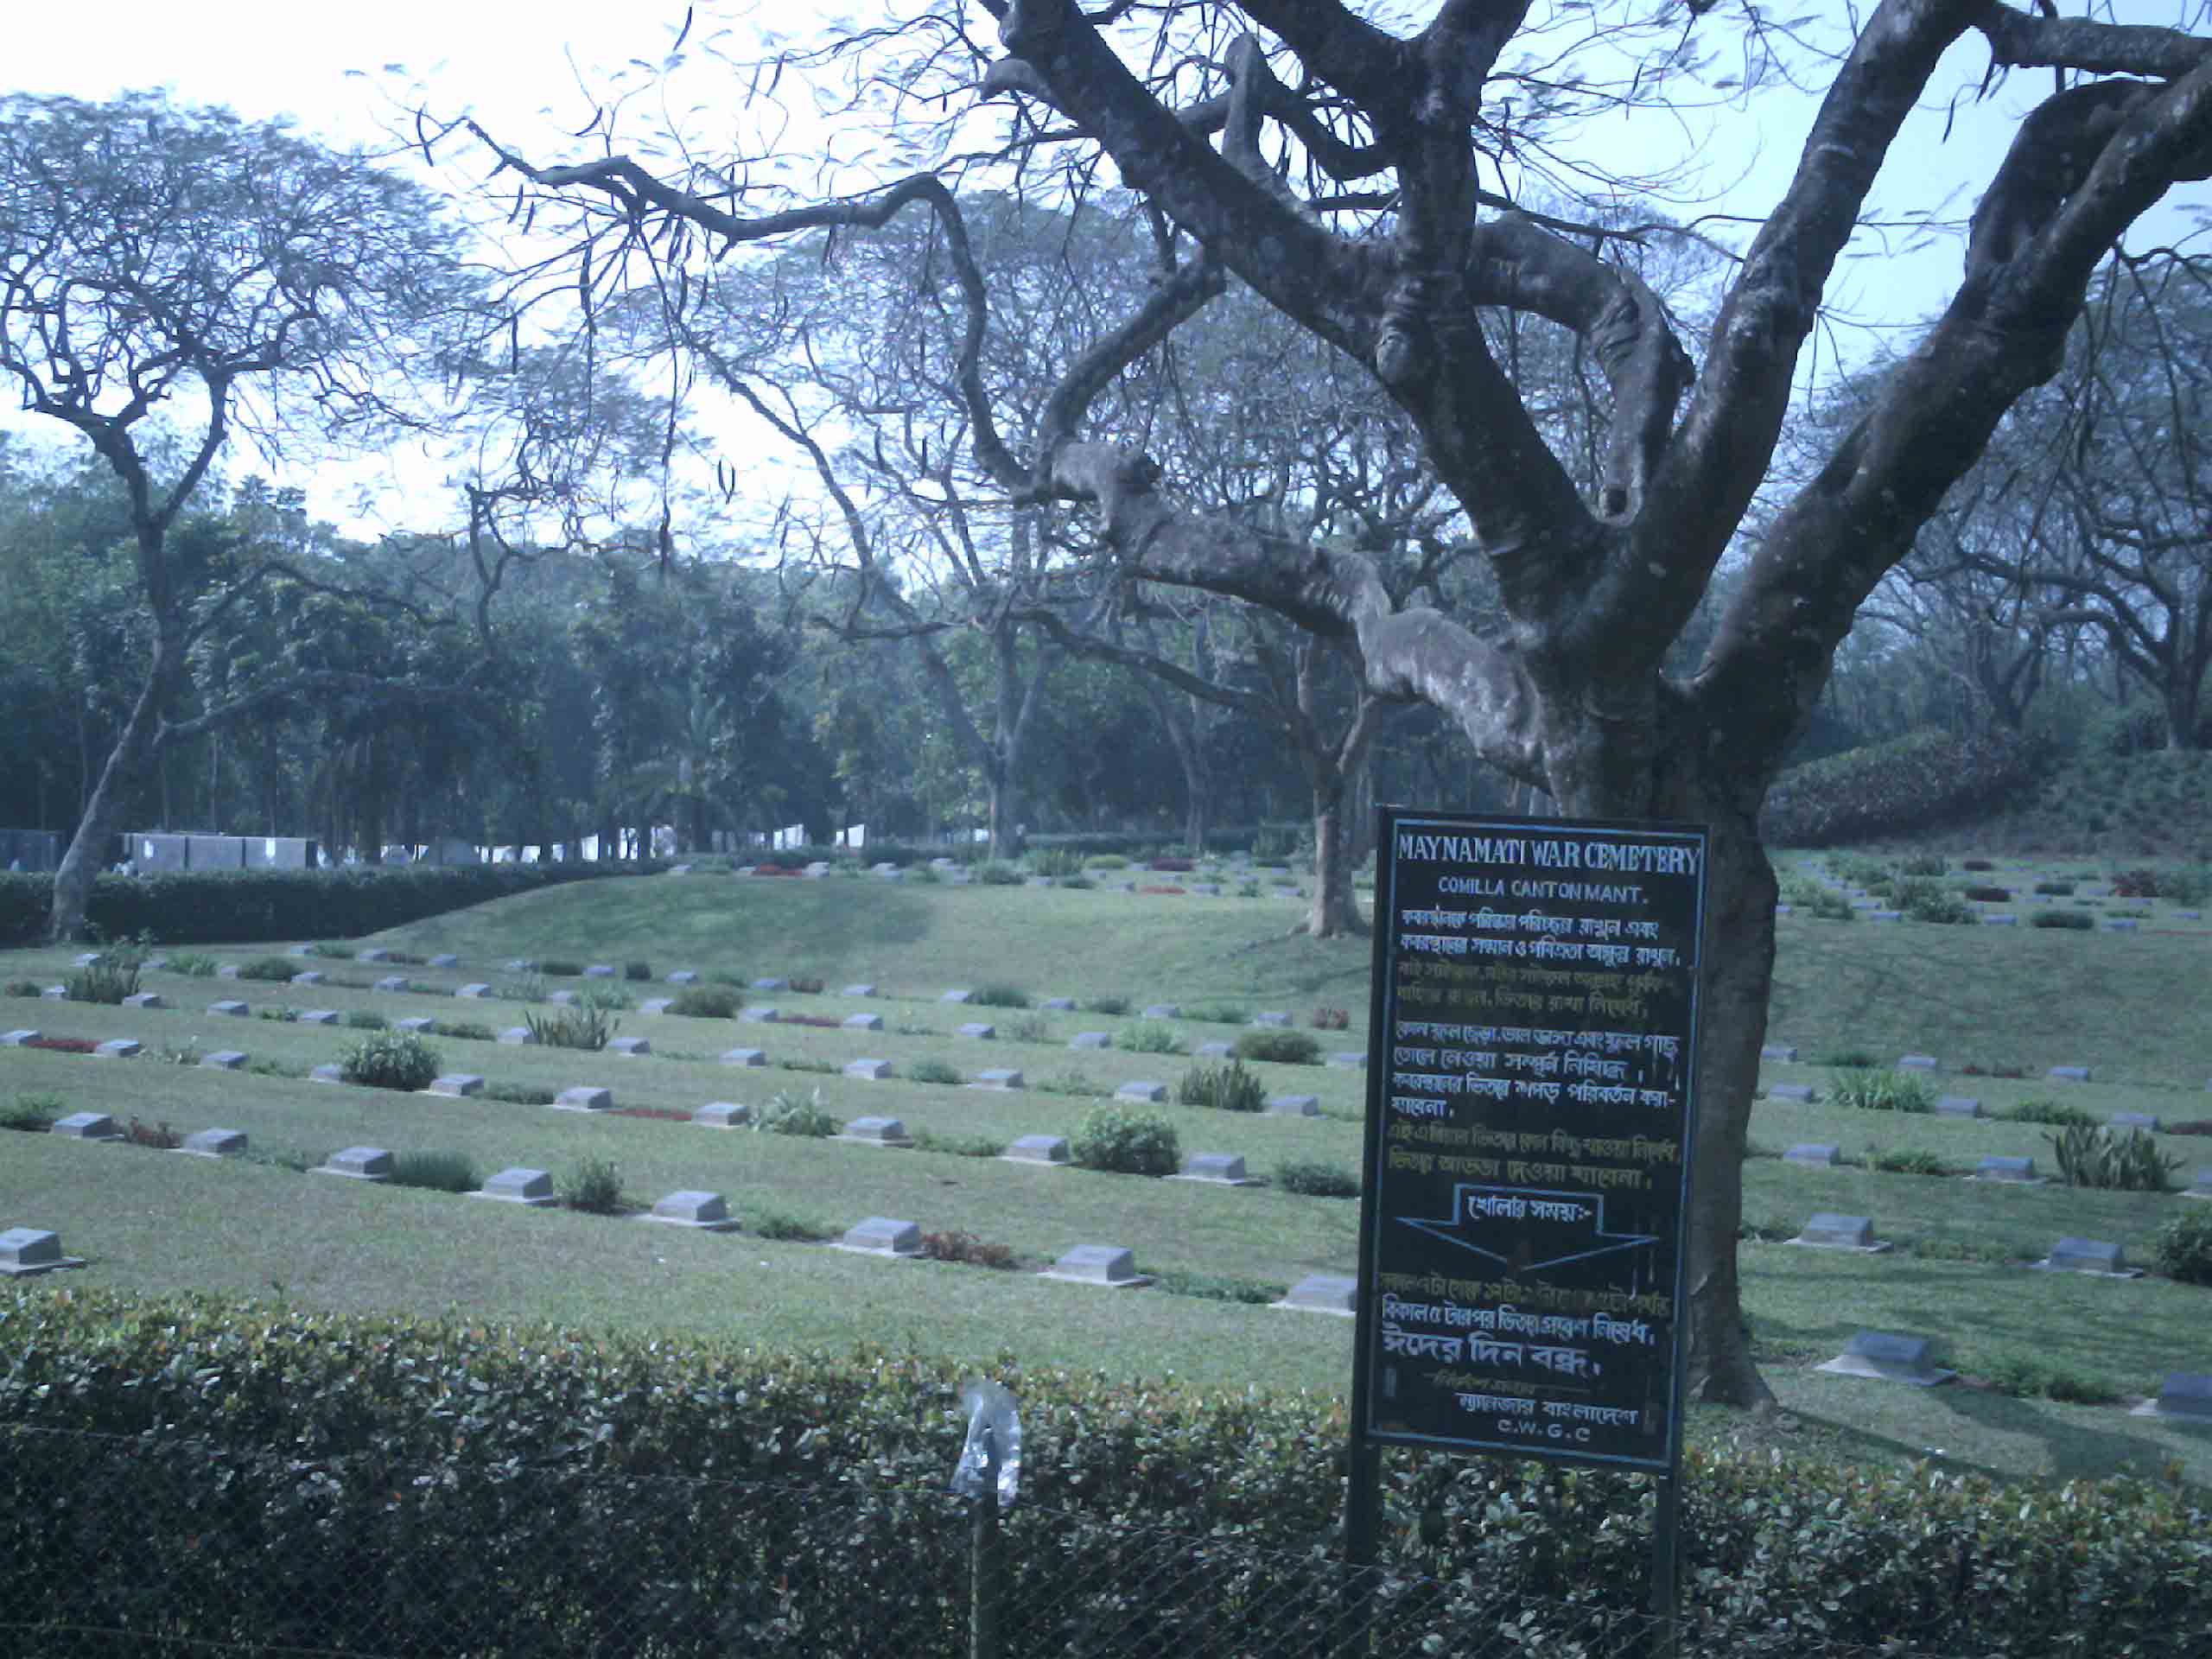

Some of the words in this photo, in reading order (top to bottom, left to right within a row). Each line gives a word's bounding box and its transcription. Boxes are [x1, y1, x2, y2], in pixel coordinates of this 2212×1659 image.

[1398, 834, 1525, 864] MAYNAMATI
[1530, 840, 1580, 868] WAR
[1584, 842, 1701, 875] CEMETERY
[1438, 875, 1504, 897] COMILLA
[1624, 921, 1659, 941] এবং
[1467, 1196, 1528, 1219] খোলার
[1382, 1321, 1464, 1363] ঈদের
[1467, 1330, 1522, 1366] দিন
